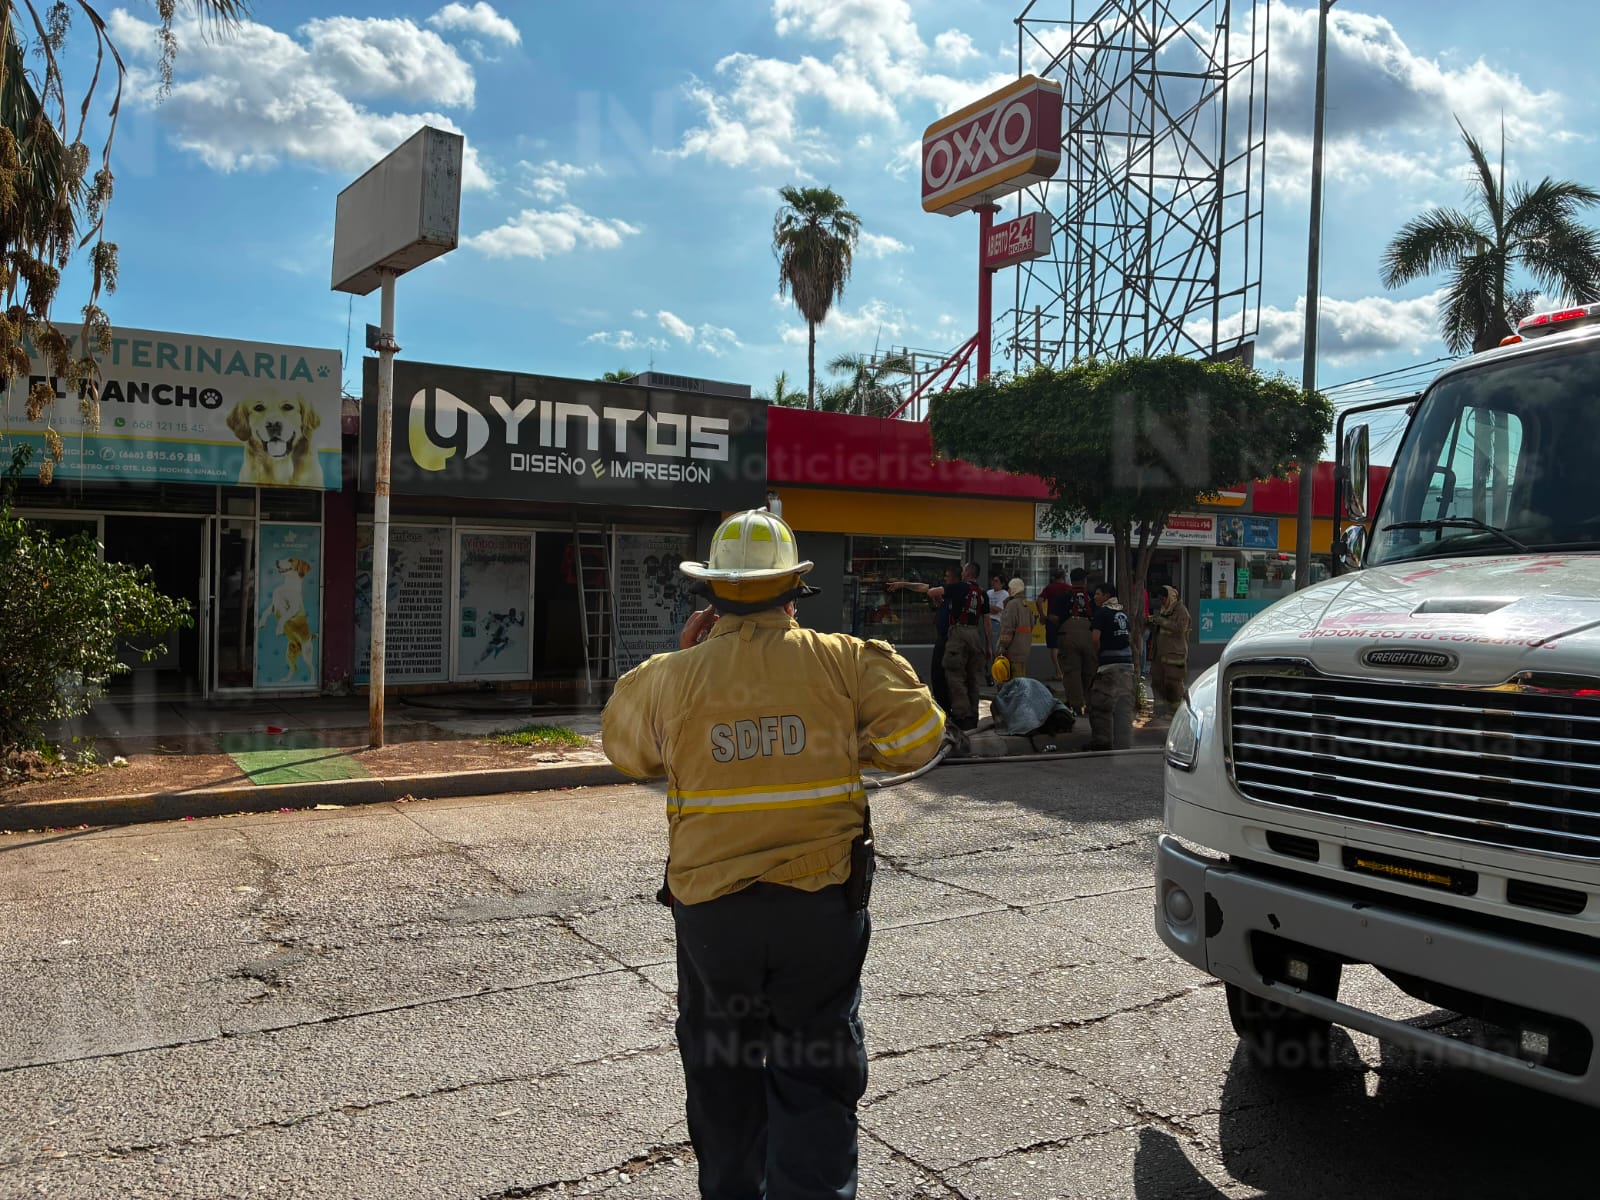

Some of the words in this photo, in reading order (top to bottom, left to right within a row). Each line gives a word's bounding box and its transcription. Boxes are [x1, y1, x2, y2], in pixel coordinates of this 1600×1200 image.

[925, 102, 1032, 189] OXXO
[1010, 217, 1032, 242] 24
[987, 229, 1008, 257] ABIERTO
[1009, 240, 1032, 256] HORAS
[78, 379, 223, 410] RANCHO
[132, 420, 152, 431] 668
[157, 421, 173, 432] 121
[146, 450, 201, 462] 815.69.88
[511, 451, 586, 476] DISEÑO
[591, 458, 606, 479] E
[610, 461, 712, 484] IMPRESIÓN
[1370, 652, 1447, 666] FREIGHTLINER
[711, 714, 807, 764] SDFD
